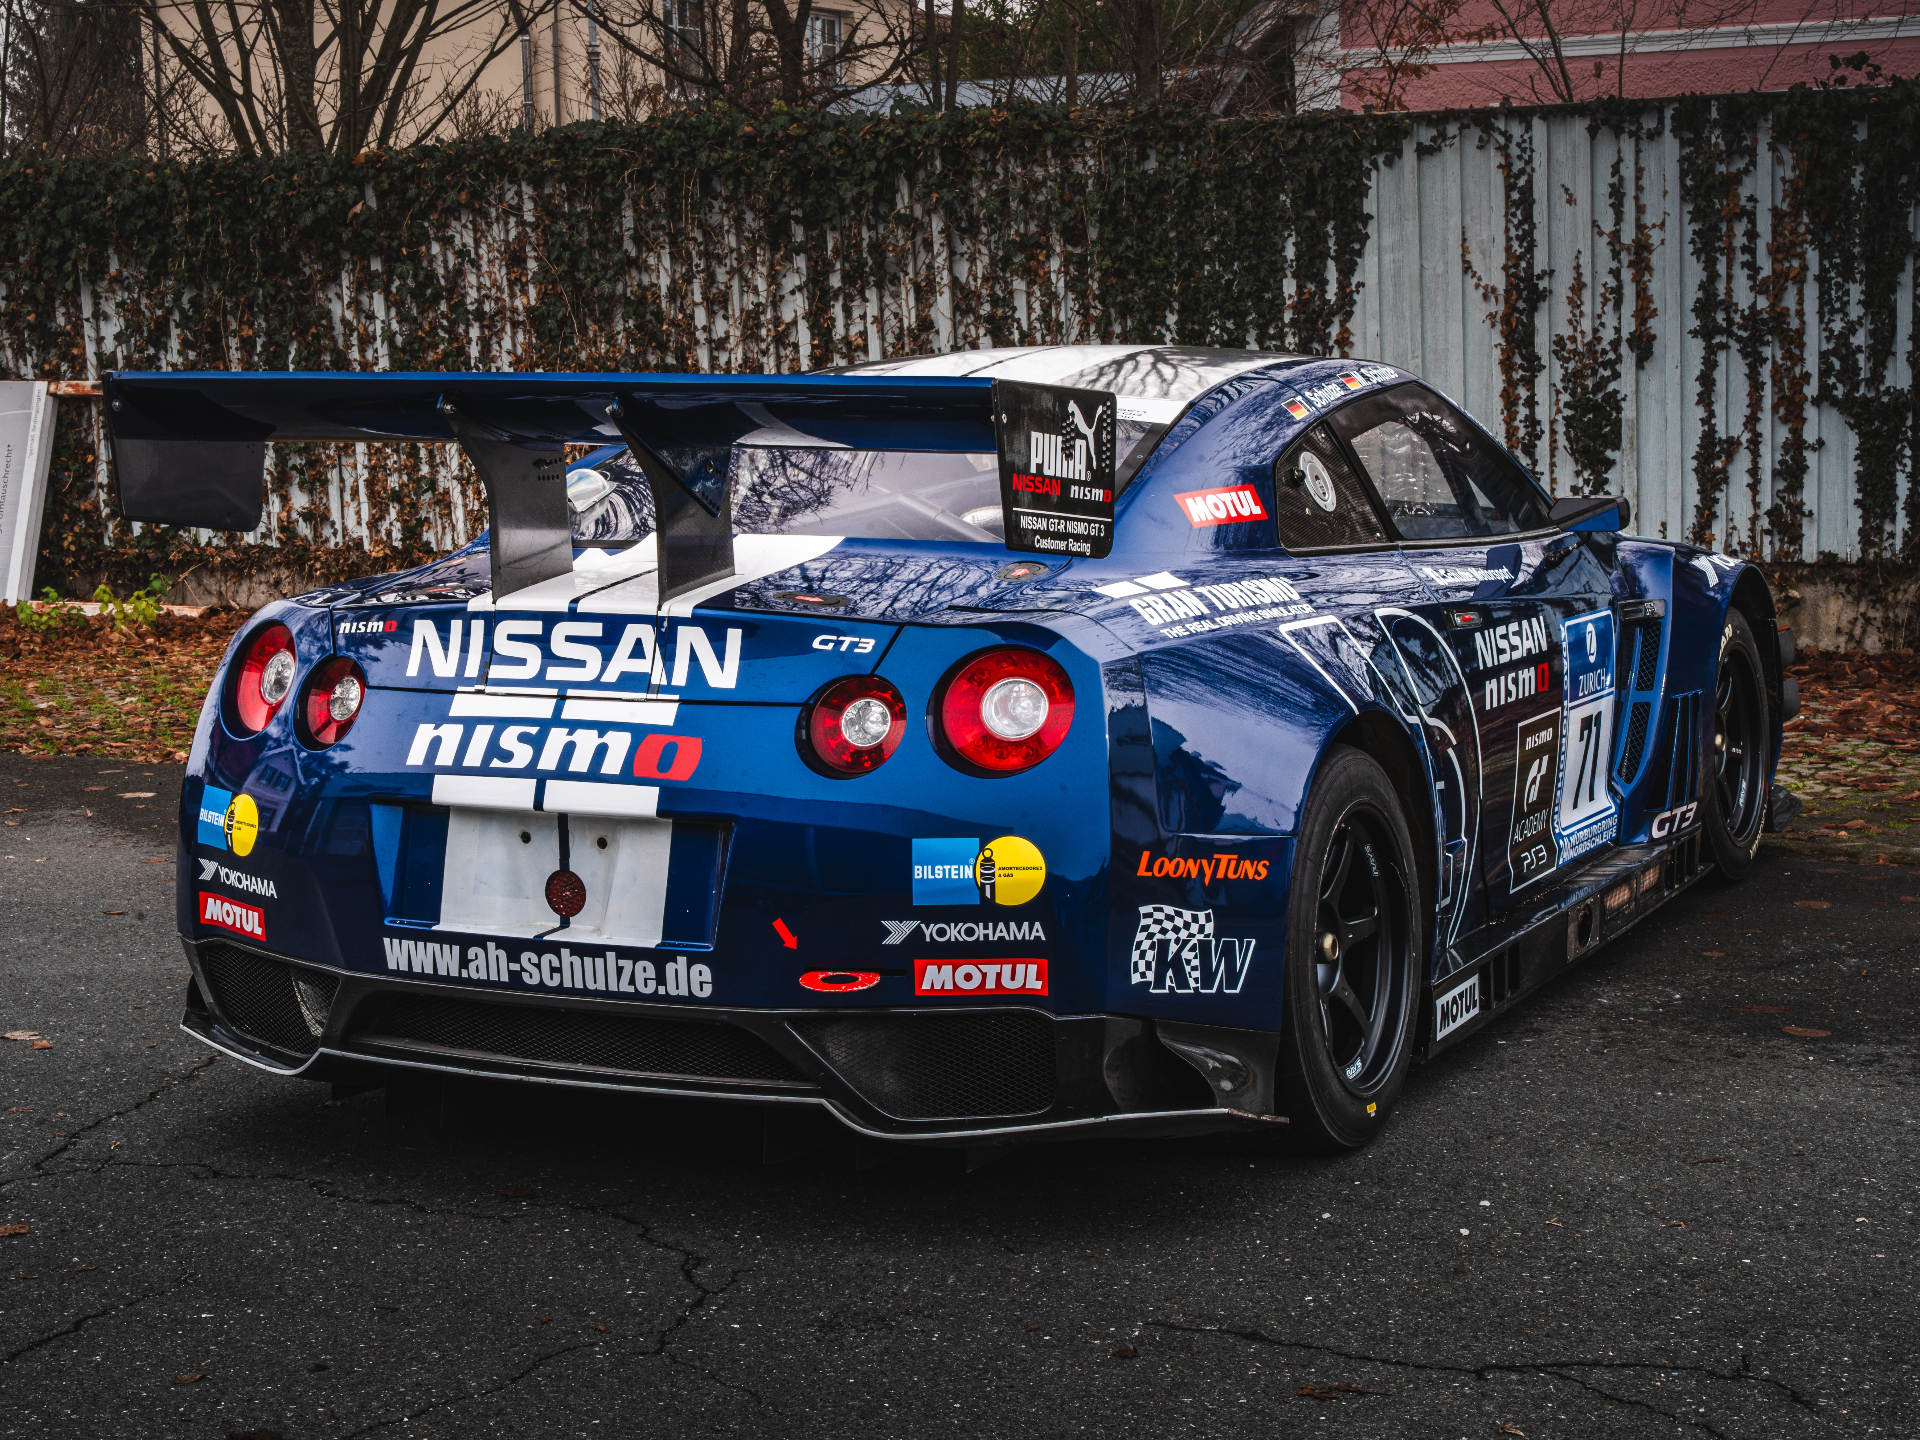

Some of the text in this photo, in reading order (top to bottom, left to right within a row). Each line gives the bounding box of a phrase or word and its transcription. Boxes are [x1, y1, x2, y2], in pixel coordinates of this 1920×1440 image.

[1360, 365, 1399, 384] Schulze
[1305, 383, 1344, 408] Schulze
[1030, 431, 1087, 481] PUMA
[1012, 473, 1112, 503] NISSAN nismo
[1184, 490, 1262, 523] MOTUL
[1020, 515, 1048, 531] NISSAN
[1048, 518, 1066, 533] GT-R
[1066, 520, 1089, 537] NISMO
[1089, 522, 1100, 537] GT
[1034, 534, 1091, 556] Customer Racing
[1128, 577, 1301, 626] GRAN TURISMO
[339, 620, 397, 634] nismo
[1160, 603, 1317, 639] THE REAL DRIVING SIMULATOR
[406, 619, 743, 689] NISSAN
[811, 634, 876, 654] GT3
[1474, 615, 1548, 670] NISSAN
[1559, 623, 1568, 691] ADAC
[1485, 662, 1550, 711] nismo
[1578, 667, 1606, 697] ZURICH
[405, 724, 702, 782] nismo
[1572, 710, 1603, 811] 71
[199, 808, 226, 828] BILSTEIN
[1512, 807, 1550, 845] ACADEMY
[1570, 814, 1618, 847] NÜRBURGRING
[1651, 801, 1698, 839] GT3
[1569, 825, 1617, 861] NORDSCHLEIFE
[217, 865, 278, 899] YOKOHAMA
[914, 865, 973, 879] BILSTEIN
[204, 897, 263, 936] MOTUL
[919, 921, 1046, 942] YOKOHAMA
[383, 937, 713, 998] www.ah-schulze.de
[921, 963, 1043, 990] MOTUL
[1149, 937, 1256, 994] KW
[1438, 982, 1478, 1033] MOTUL
